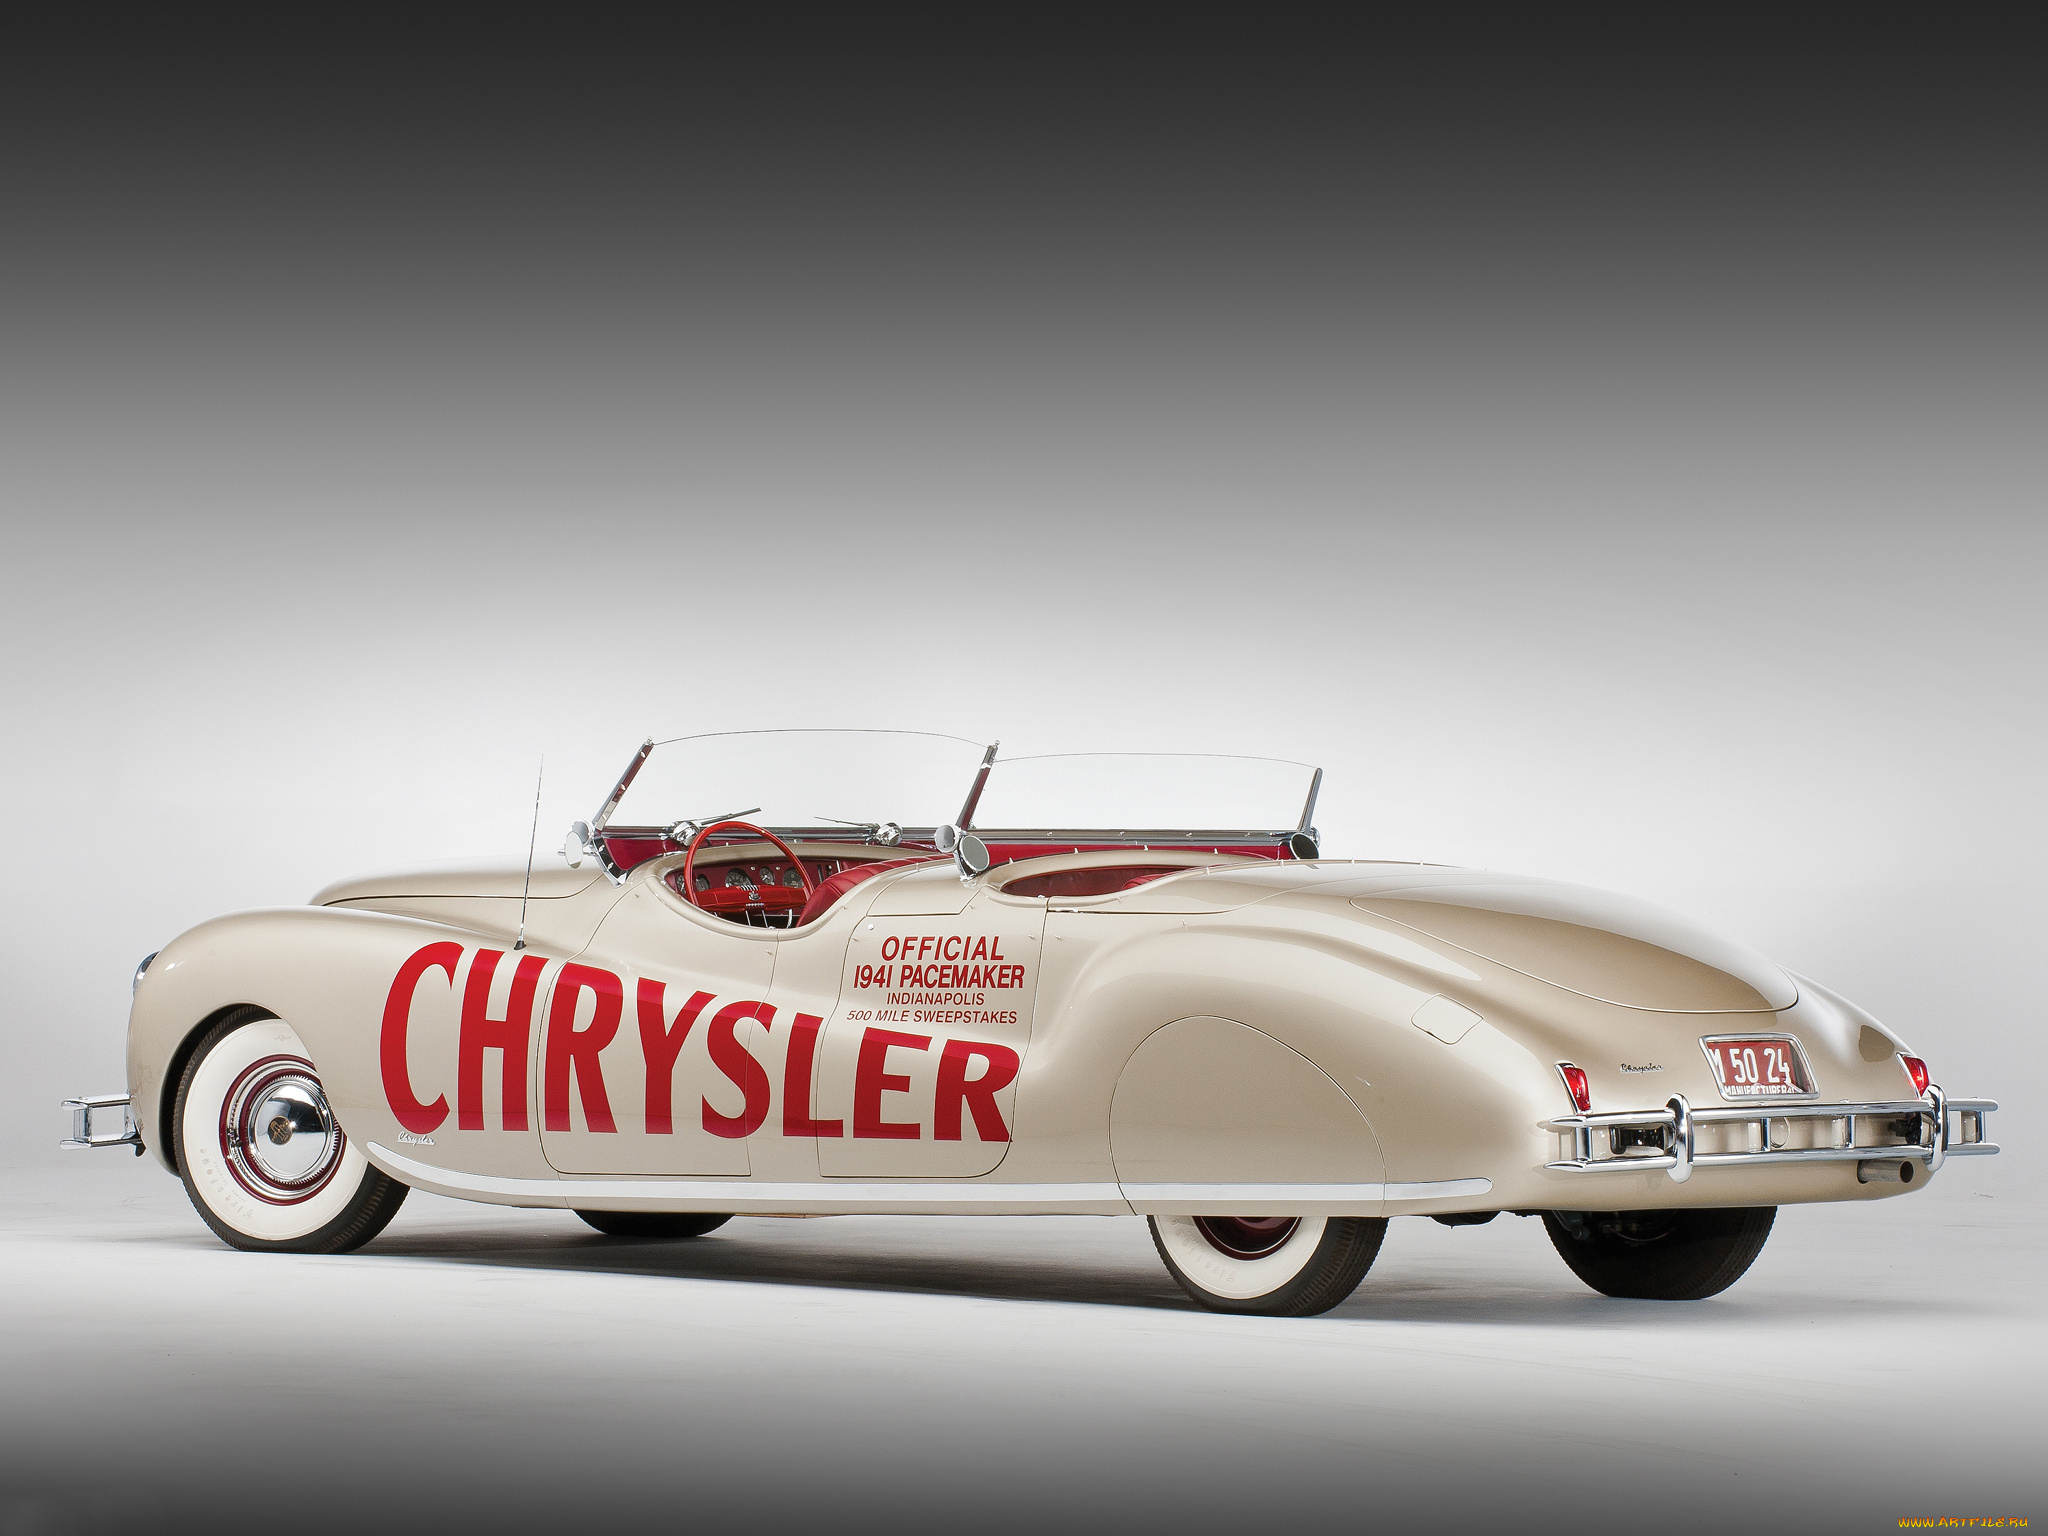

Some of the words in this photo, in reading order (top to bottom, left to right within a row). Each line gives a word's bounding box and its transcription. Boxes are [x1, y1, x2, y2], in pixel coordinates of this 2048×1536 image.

[881, 935, 1005, 962] OFFICIAL
[853, 964, 893, 989] 1941
[899, 964, 1025, 989] PACEMAKER
[886, 992, 985, 1006] INDIANAPOLIS
[846, 1010, 872, 1021] 500
[874, 1010, 910, 1022] MILE
[913, 1010, 1018, 1024] SWEEPSTAKES
[380, 941, 1021, 1143] CHRYSLER
[1729, 1048, 1759, 1083] 50
[1763, 1048, 1792, 1084] 24
[397, 1130, 436, 1147] Chrysler
